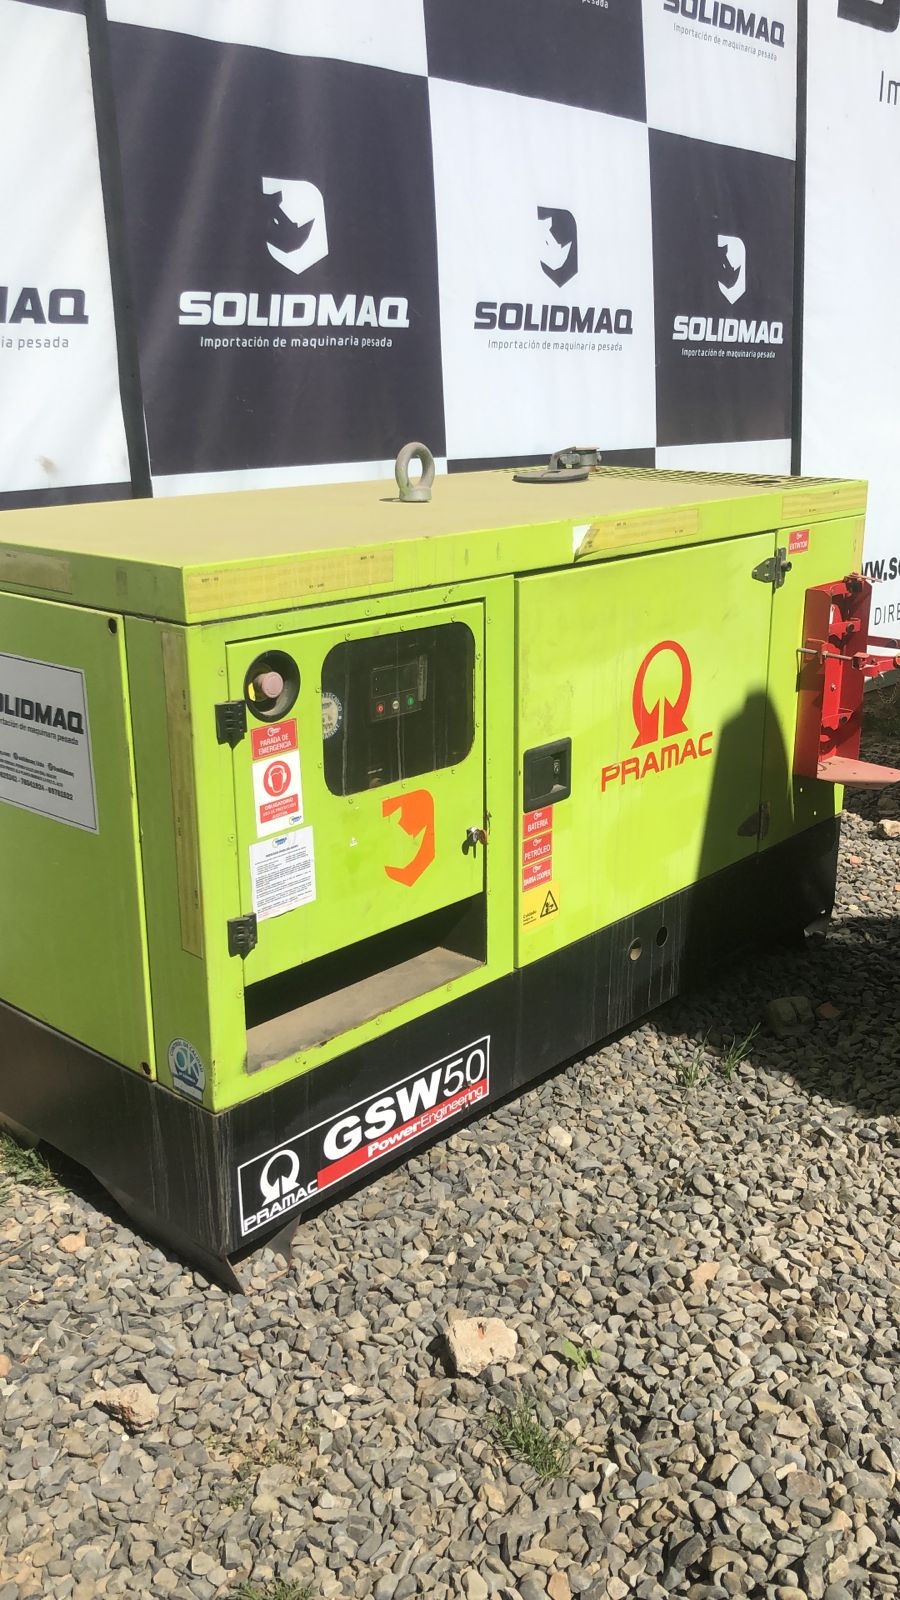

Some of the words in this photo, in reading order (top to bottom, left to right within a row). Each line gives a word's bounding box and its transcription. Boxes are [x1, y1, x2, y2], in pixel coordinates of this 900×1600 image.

[673, 23, 712, 42] Importación
[713, 36, 721, 44] de
[722, 38, 757, 55] maquinaria
[757, 48, 778, 61] pesada
[178, 291, 410, 328] SOLIDMAQ
[473, 301, 634, 335] SOLIDMAQ
[672, 315, 784, 344] SOLIDMAQ
[17, 336, 70, 350] pesada
[200, 335, 270, 349] Importación
[272, 336, 287, 348] de
[290, 335, 359, 349] maquinaria
[361, 336, 393, 348] pesada
[488, 339, 540, 351] Importación
[541, 340, 551, 350] de
[552, 341, 596, 352] maquinaria
[597, 342, 623, 352] pesada
[681, 347, 717, 358] Importación
[718, 348, 725, 357] de
[726, 349, 756, 358] maquinaria
[756, 350, 776, 359] pesada
[0, 692, 84, 735] LIDMAQ
[57, 734, 79, 746] pesada
[258, 740, 292, 755] EMERGENCIA
[259, 735, 281, 748] PARADA
[281, 733, 289, 741] DE
[601, 731, 713, 793] PRAMAC
[524, 844, 551, 861] PETRÓLEO
[243, 1179, 318, 1231] PRAMAC
